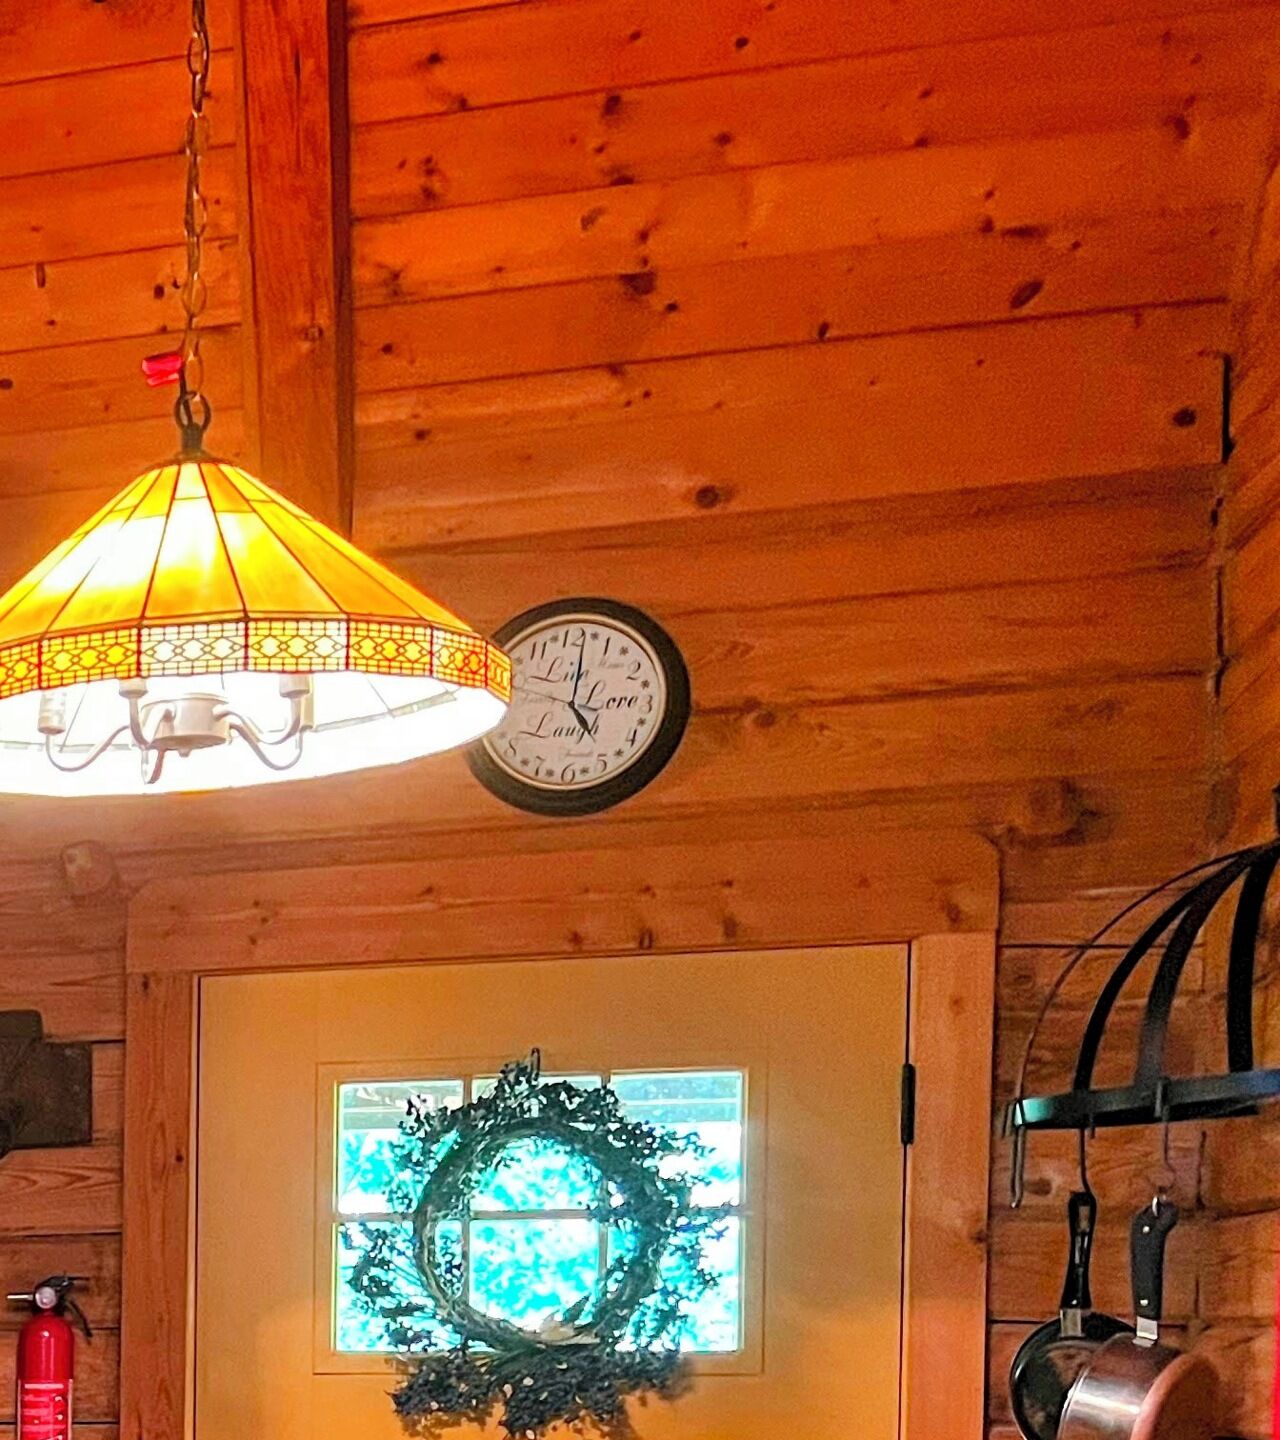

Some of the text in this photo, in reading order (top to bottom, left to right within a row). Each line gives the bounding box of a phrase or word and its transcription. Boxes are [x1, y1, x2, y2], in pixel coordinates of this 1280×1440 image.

[562, 627, 586, 648] 12
[603, 636, 611, 657] 1
[530, 641, 547, 661] 11
[626, 661, 641, 681] 2
[576, 679, 639, 713] Love
[640, 694, 653, 714] 3
[519, 711, 601, 745] Laugh
[625, 728, 638, 748] 4
[533, 755, 547, 777] 7
[560, 762, 577, 784] 6
[594, 753, 609, 773] 5
